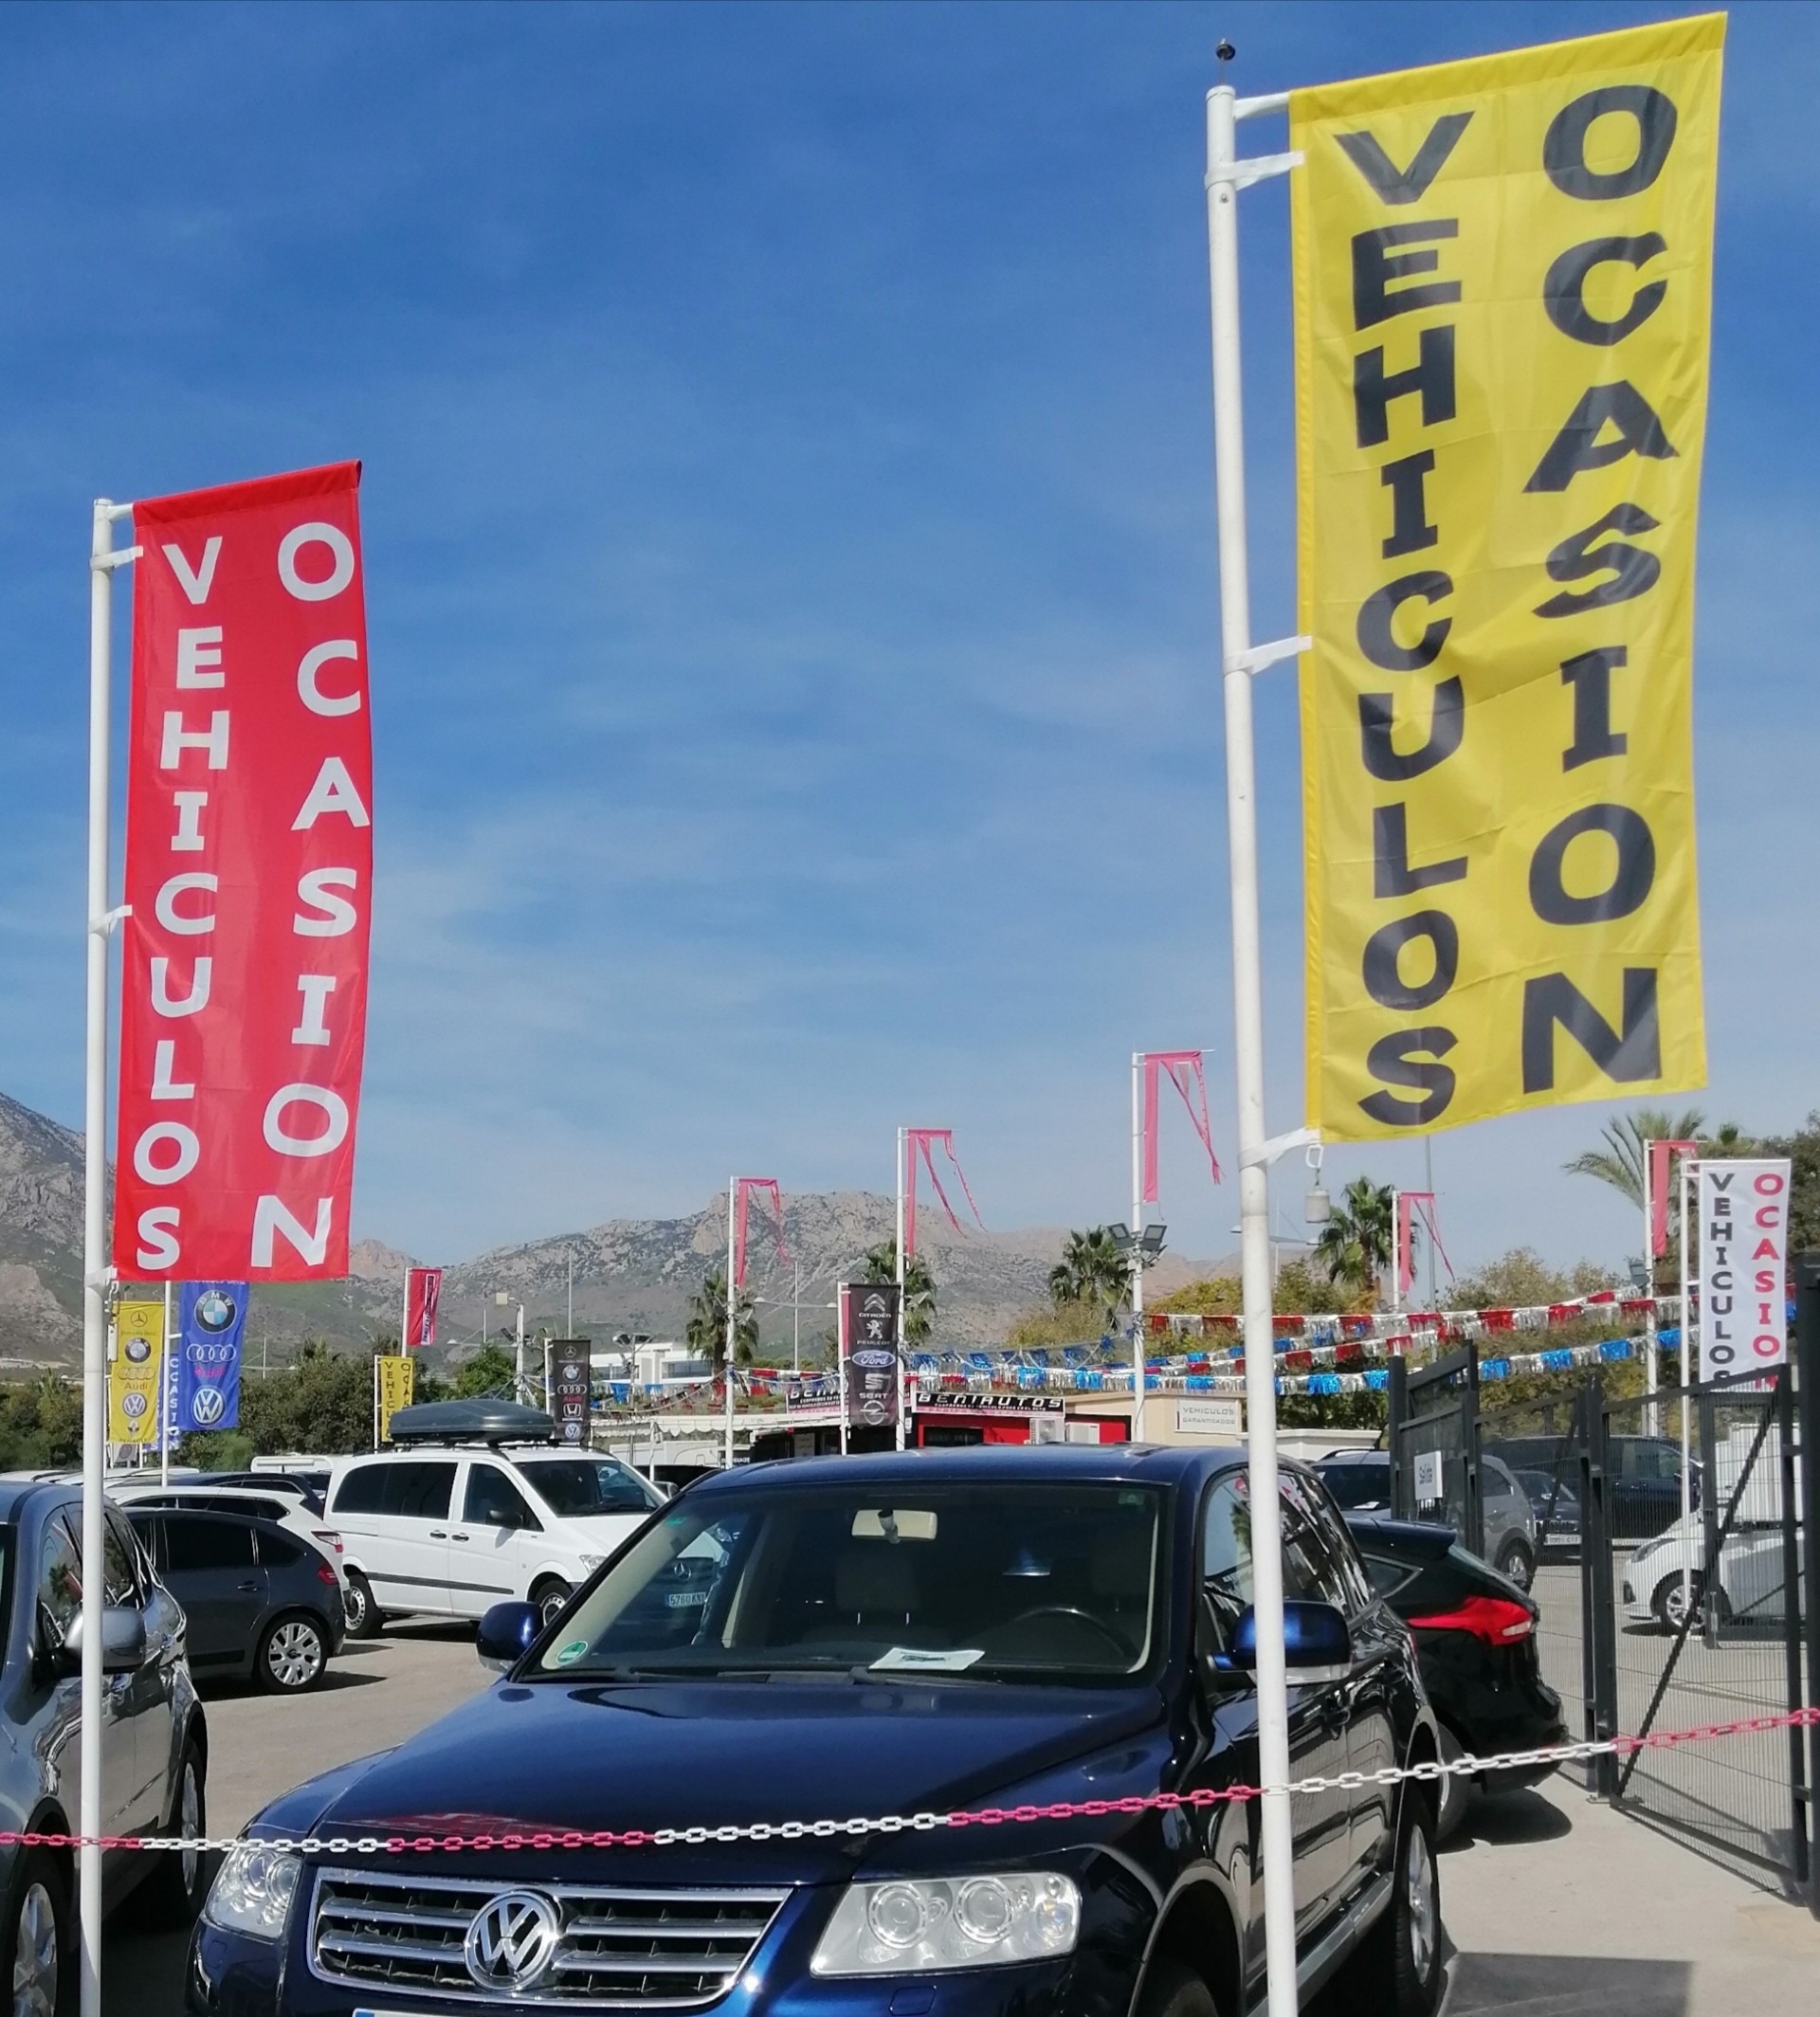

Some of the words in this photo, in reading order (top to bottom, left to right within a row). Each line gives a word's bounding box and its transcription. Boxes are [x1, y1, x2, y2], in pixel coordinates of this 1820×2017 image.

[1333, 110, 1475, 1127] VEHICULOS
[1521, 83, 1680, 1096] OCASION
[133, 536, 230, 1270] VEHICULOS
[250, 521, 371, 1268] OCASION
[124, 1382, 148, 1390] Audi
[860, 1353, 888, 1366] Ford
[919, 1393, 1063, 1408] BENIAUTOS
[1183, 1407, 1235, 1415] VEHICULOS
